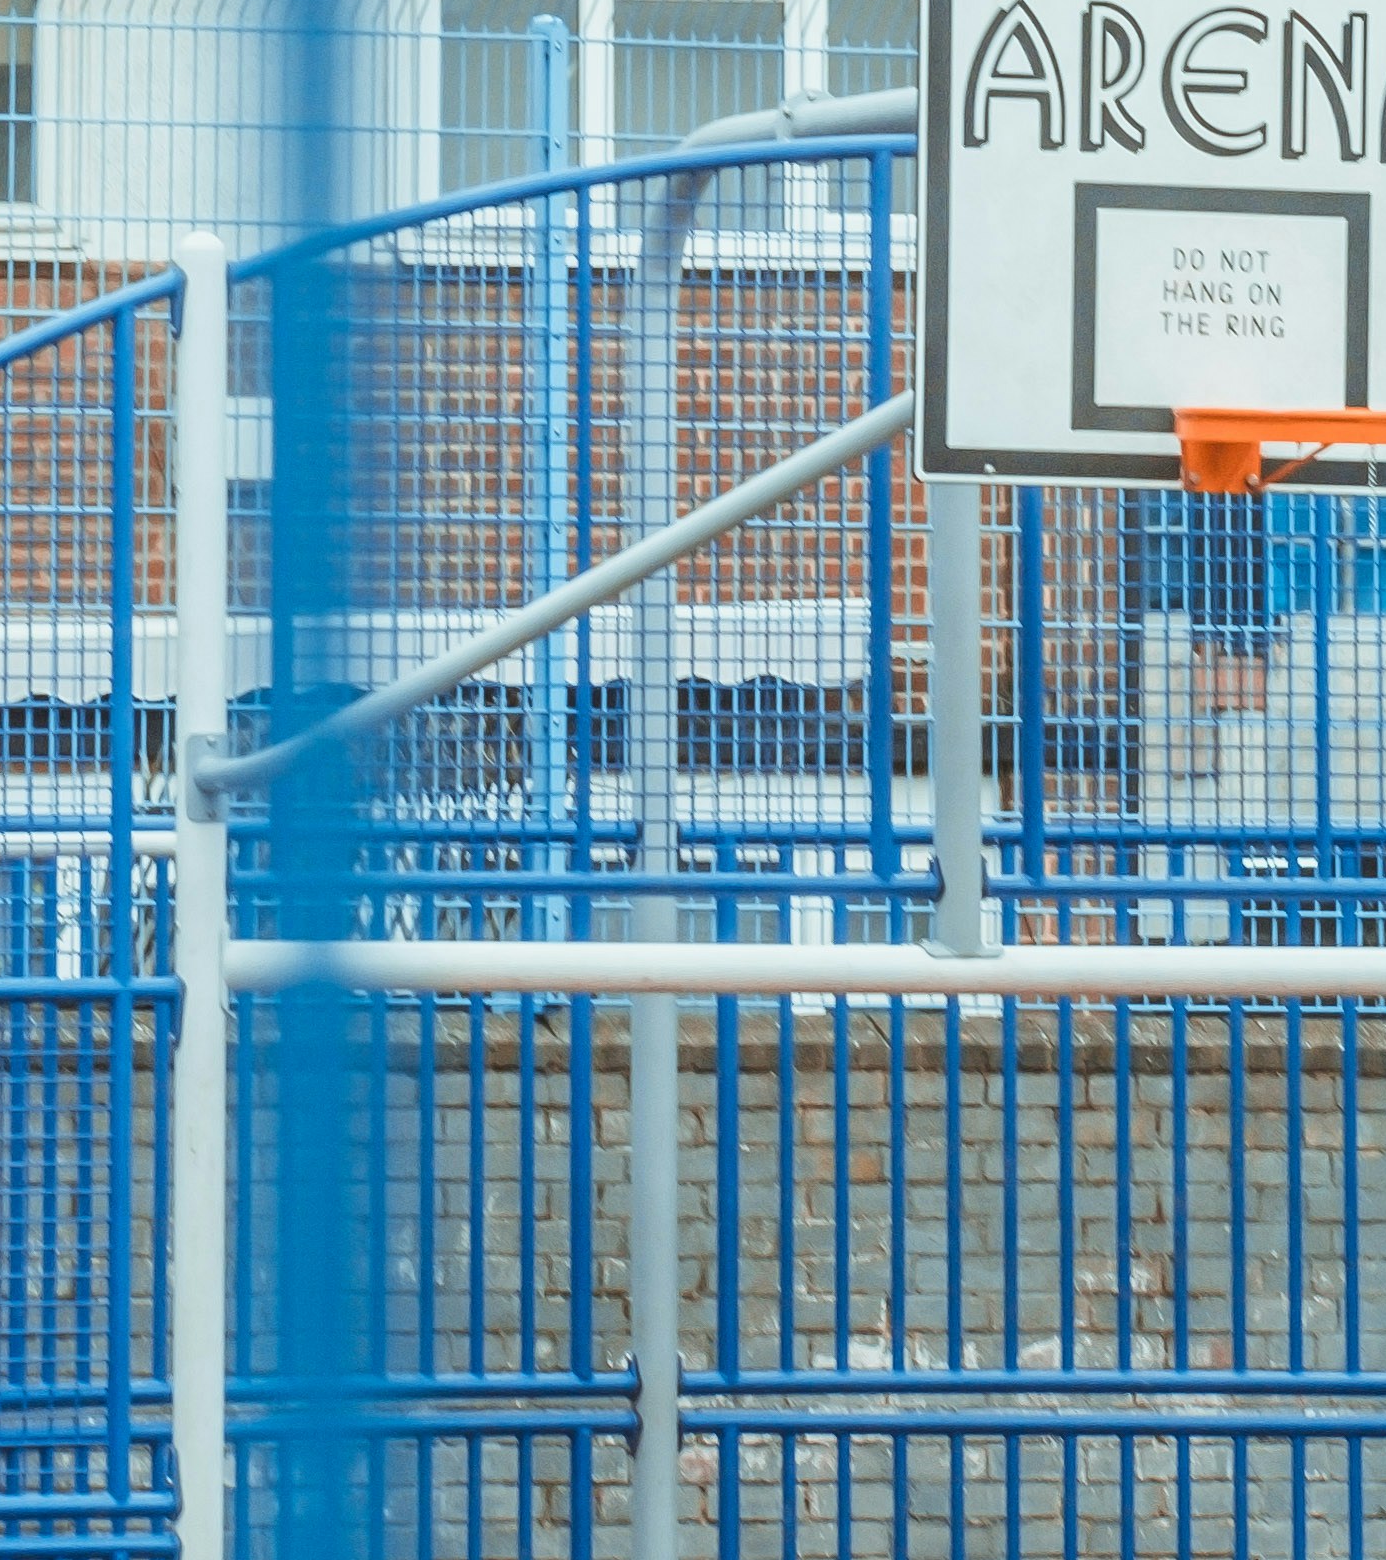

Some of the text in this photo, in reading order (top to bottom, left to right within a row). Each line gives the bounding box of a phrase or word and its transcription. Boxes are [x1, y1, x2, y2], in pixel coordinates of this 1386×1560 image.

[1173, 246, 1271, 274] DO NOT
[1162, 279, 1282, 307] HANG ON
[1159, 311, 1286, 339] THE RING
